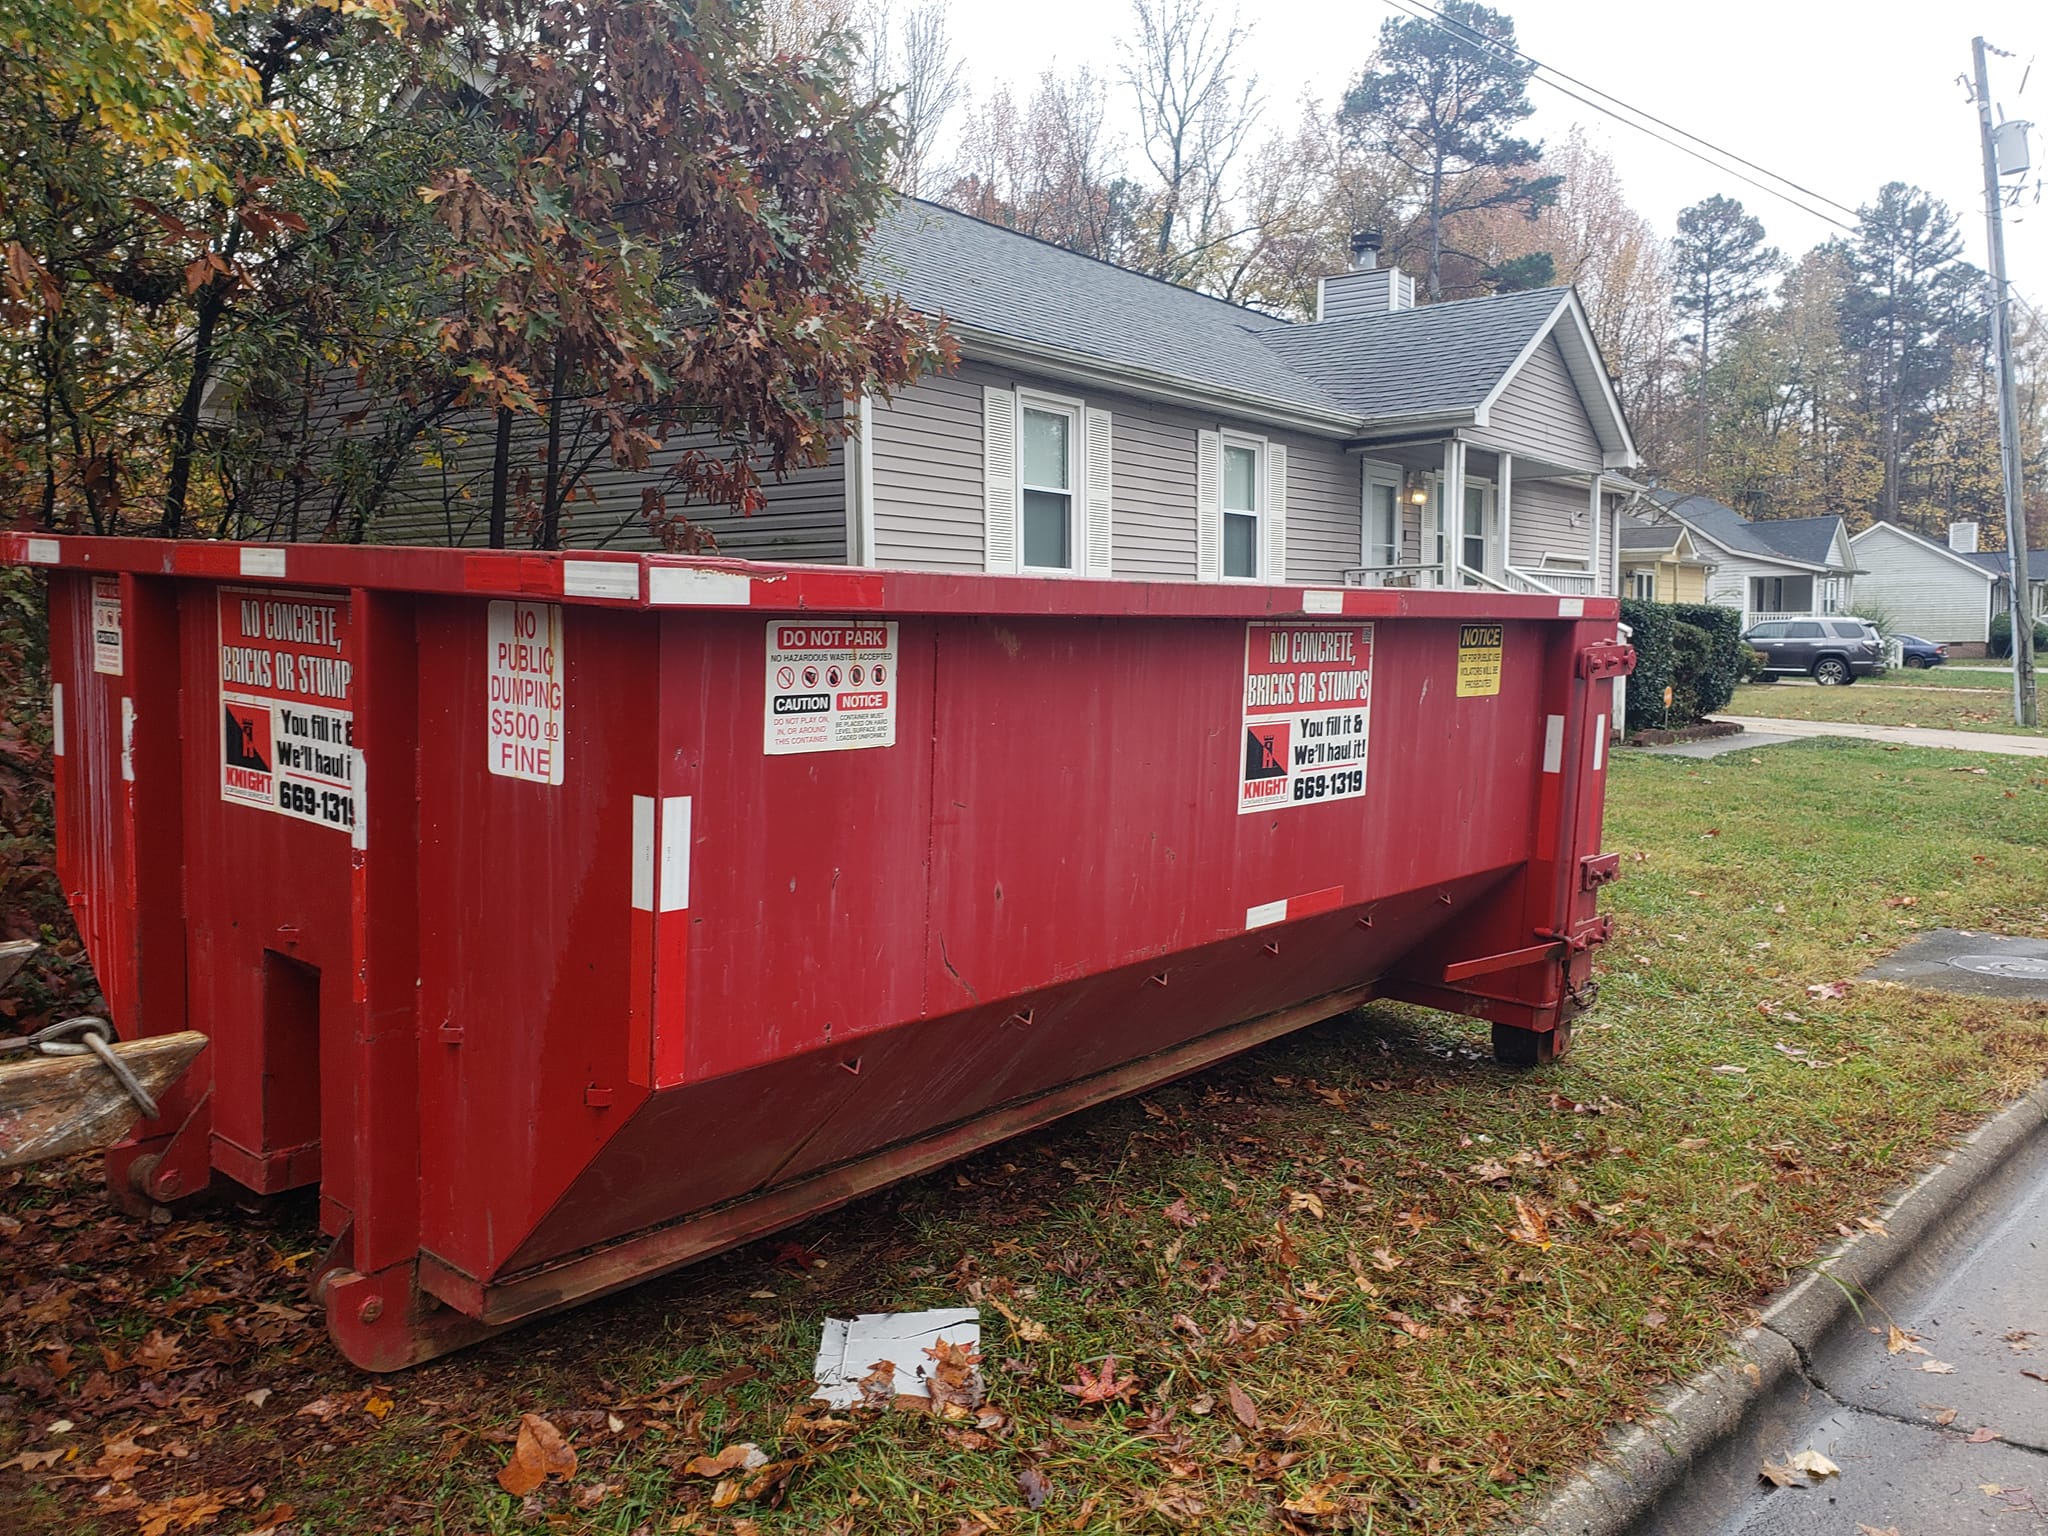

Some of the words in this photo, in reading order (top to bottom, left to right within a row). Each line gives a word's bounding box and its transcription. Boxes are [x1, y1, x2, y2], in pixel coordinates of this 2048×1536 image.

[241, 600, 260, 638] NO
[264, 601, 343, 654] CONCRETE,
[514, 610, 536, 639] NO
[1462, 628, 1500, 646] NOTICE
[783, 630, 806, 647] DO
[810, 630, 842, 646] NOT
[845, 630, 883, 646] PARK
[1269, 631, 1288, 664] NO
[1292, 631, 1357, 666] CONCRETE,
[498, 643, 555, 676] PUBLIC
[784, 654, 828, 662] HAZARDOUS
[830, 653, 857, 661] WASTES
[222, 645, 272, 688] BRICKS
[275, 651, 296, 691] OR
[298, 655, 353, 699] STUMP
[491, 675, 561, 711] DUMPING
[842, 694, 883, 708] NOTICE
[1248, 672, 1295, 707] BRICKS
[1298, 672, 1316, 704] OR
[1319, 670, 1369, 703] STUMPS
[775, 697, 829, 711] CAUTION
[281, 709, 308, 739] You
[311, 714, 330, 743] fill
[332, 717, 342, 745] it
[774, 718, 784, 726] DO
[786, 717, 798, 725] NOT
[800, 716, 817, 724] PLAY
[840, 713, 869, 721] CONTAINER
[1300, 718, 1323, 738] You
[1326, 715, 1341, 736] fill
[1342, 715, 1352, 735] it
[1353, 715, 1363, 733] &
[775, 737, 791, 745] THIS
[791, 736, 828, 744] CONTAINER
[787, 727, 797, 735] OR
[798, 726, 826, 734] AROUND
[835, 727, 852, 735] LEVEL
[853, 726, 876, 734] SURFACE
[836, 734, 857, 742] LOADED
[277, 741, 313, 772] We'll
[315, 748, 344, 779] haul
[501, 742, 551, 777] FINE
[1294, 743, 1325, 766] We'll
[1327, 741, 1351, 762] haul
[1352, 739, 1366, 760] it!
[225, 766, 272, 794] KNIGHT
[1243, 779, 1288, 798] KNIGHT
[1294, 770, 1363, 800] 669-1319
